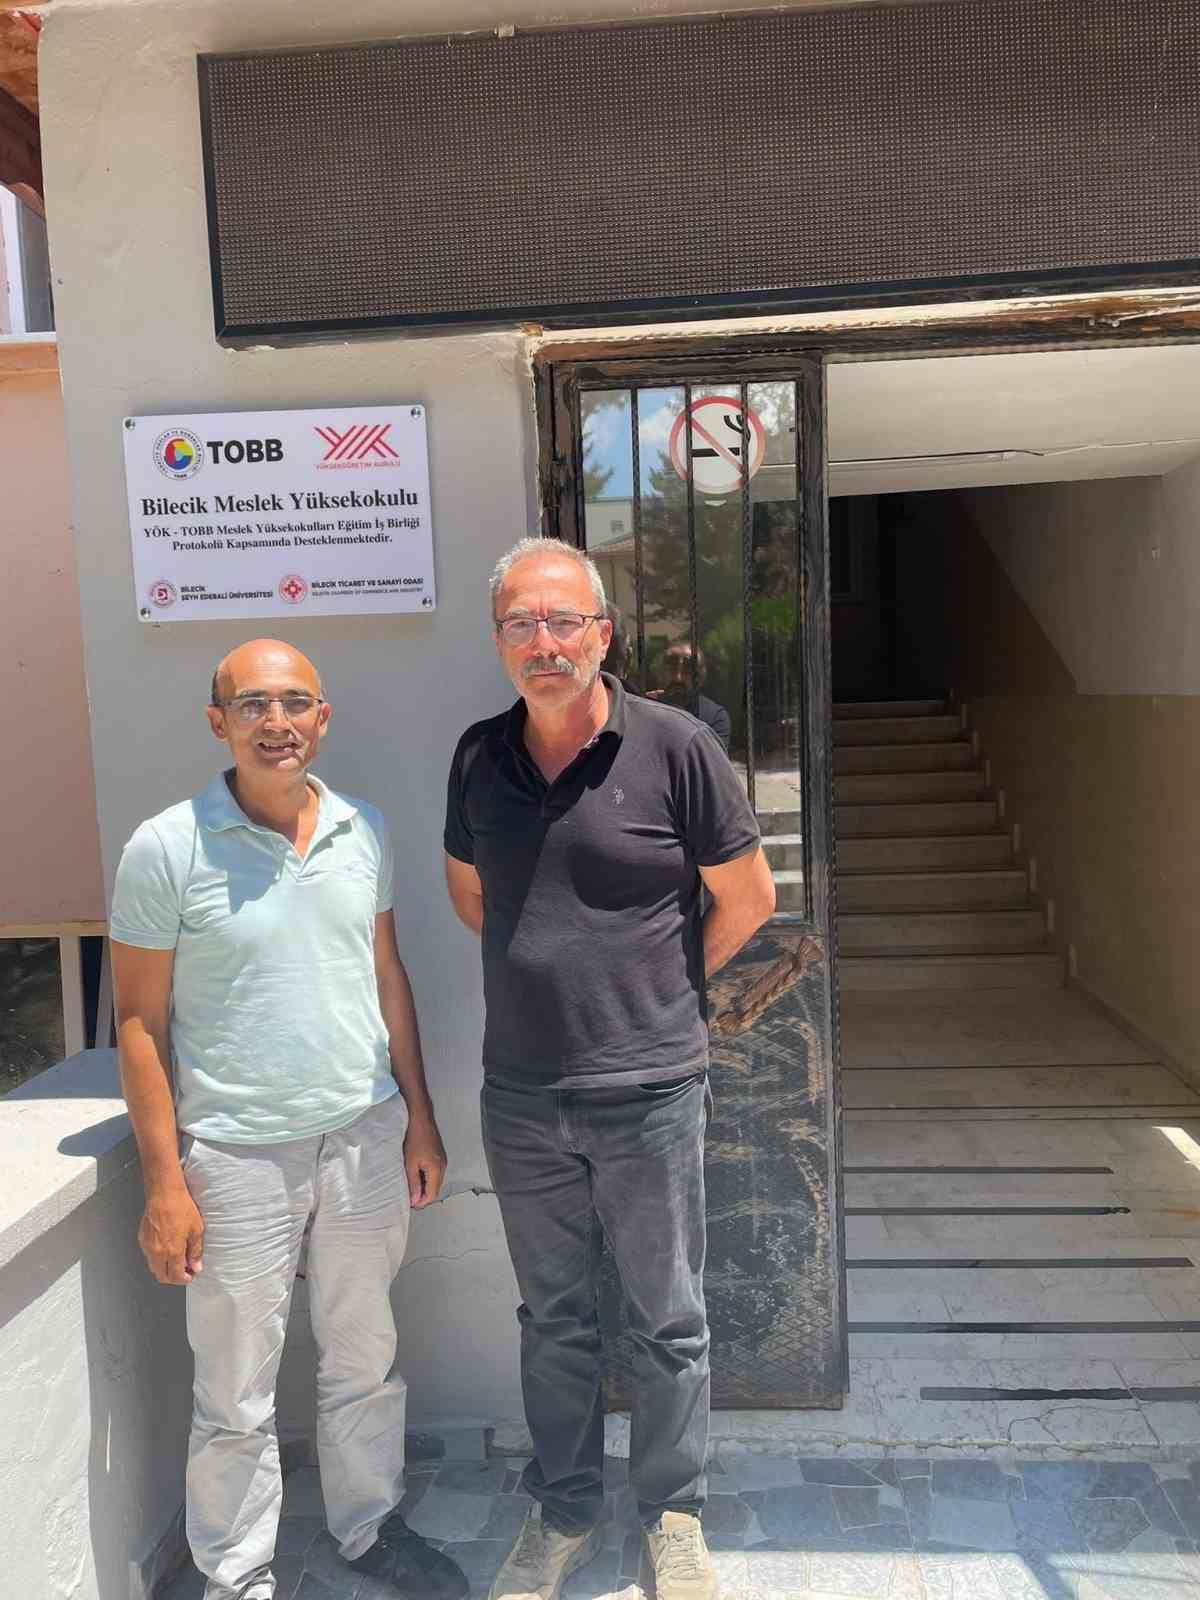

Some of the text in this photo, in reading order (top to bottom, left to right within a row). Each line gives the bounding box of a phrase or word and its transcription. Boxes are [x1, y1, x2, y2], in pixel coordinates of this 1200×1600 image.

[206, 438, 284, 465] TOBB
[141, 488, 419, 516] Bilecik Meslek Yüksekokulu
[144, 525, 171, 538] YÖK
[180, 526, 214, 537] TOBB
[216, 524, 253, 536] Meslek
[256, 520, 335, 534] Yüksekokulları
[338, 519, 373, 532] Eğitim
[375, 516, 385, 531] İş
[387, 516, 421, 530] Birliği
[172, 533, 393, 551] Protokolü Kapsamında Desteklenmektedir.
